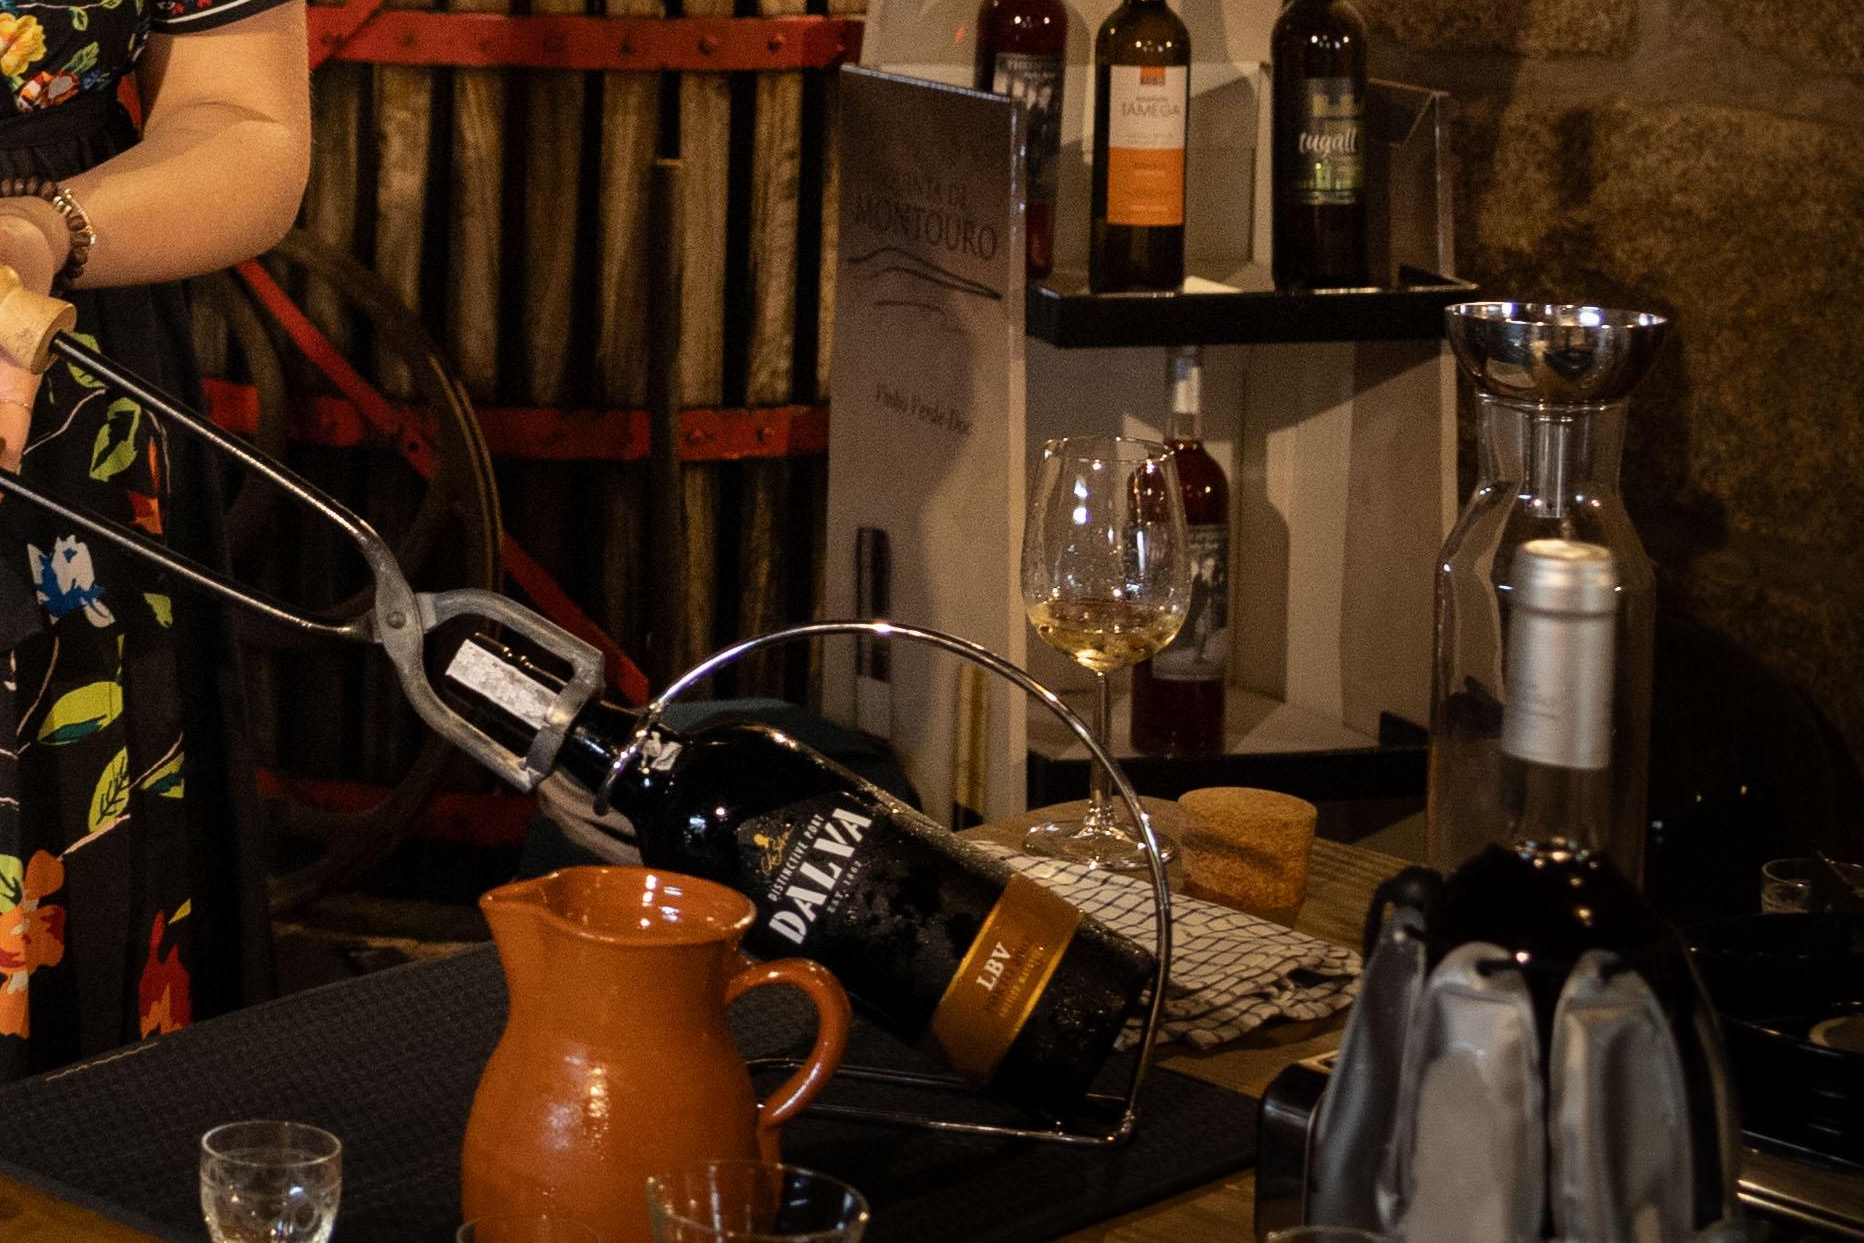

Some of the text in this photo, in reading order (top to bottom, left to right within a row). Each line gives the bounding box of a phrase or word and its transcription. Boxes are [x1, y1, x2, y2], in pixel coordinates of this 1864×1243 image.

[852, 194, 999, 262] MONTOURO
[768, 840, 809, 903] DISTINCTIVE
[803, 813, 825, 840] PORT
[768, 807, 873, 945] DALVA
[975, 941, 1012, 992] LBV
